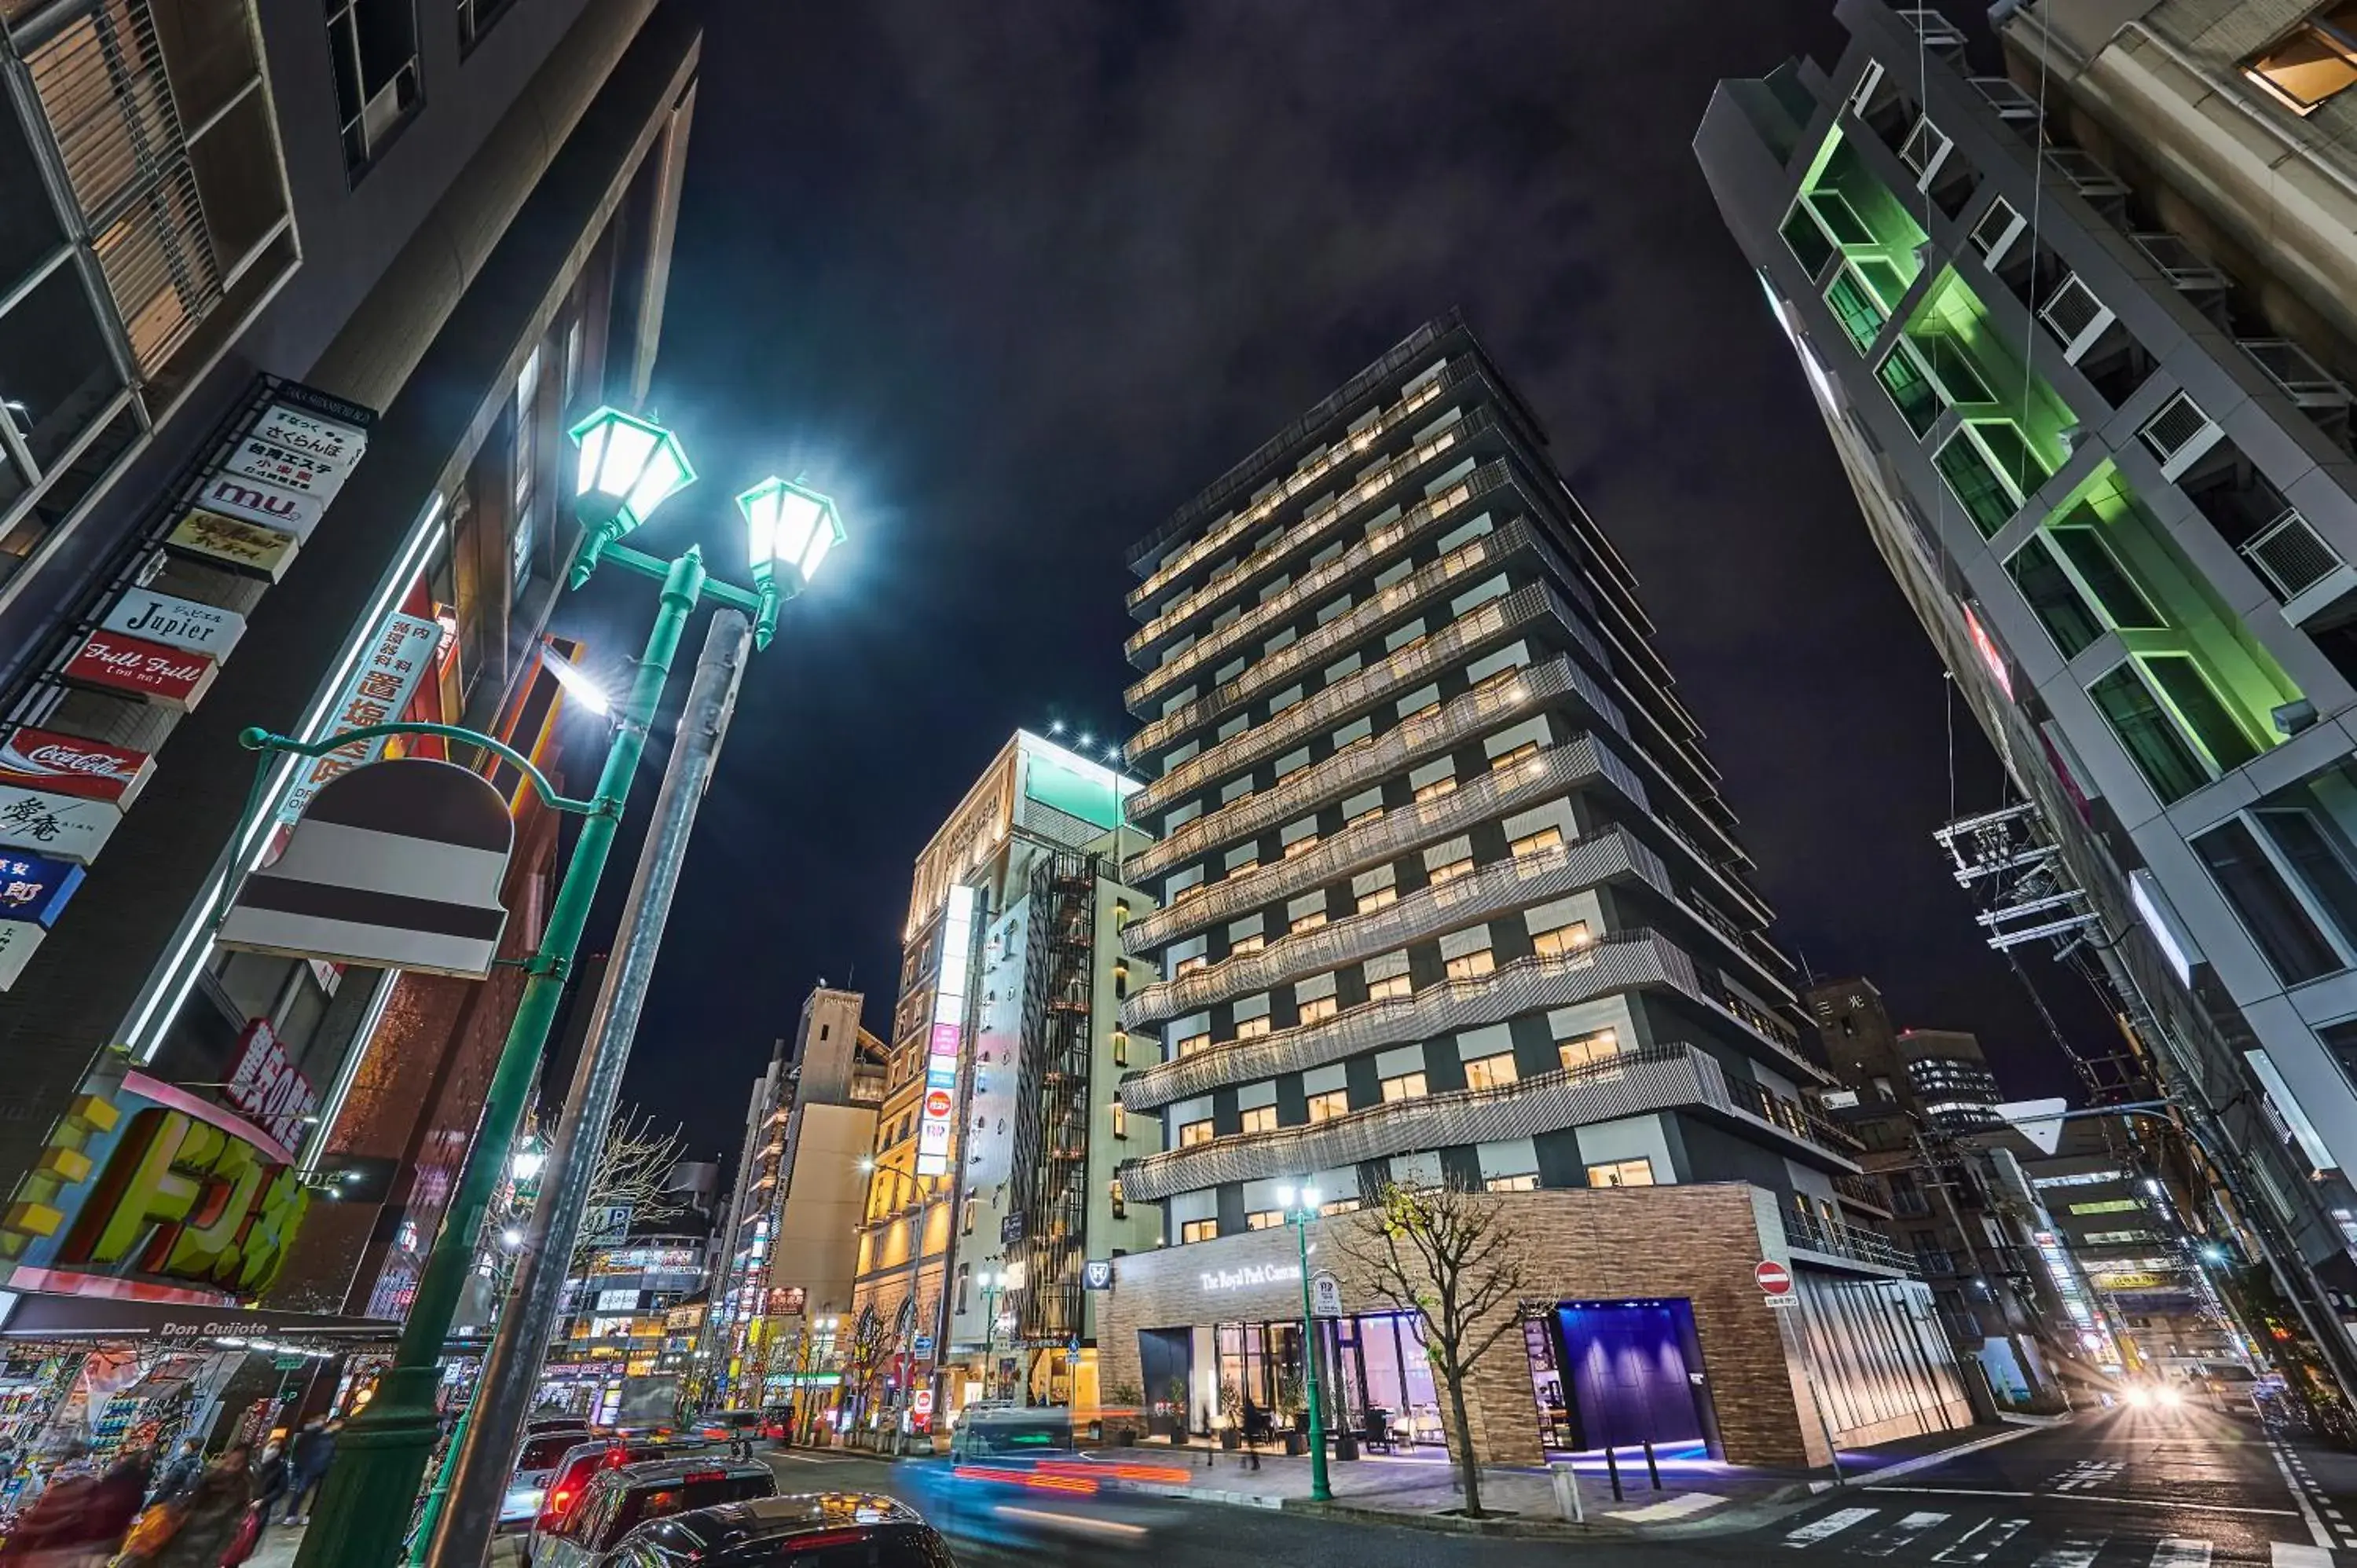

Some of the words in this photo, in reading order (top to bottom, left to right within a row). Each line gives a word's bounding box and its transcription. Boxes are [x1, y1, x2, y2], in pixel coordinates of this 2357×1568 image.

[265, 425, 345, 458] さくらんぼ
[126, 602, 214, 642] Jupier
[84, 642, 144, 668] Frill
[145, 655, 200, 682] Frill
[27, 743, 128, 776] Coca-Cola
[1199, 1273, 1219, 1291] The
[1218, 1268, 1243, 1291] Royal
[1243, 1265, 1265, 1284] Park
[160, 1321, 198, 1335] Don
[203, 1321, 268, 1336] Quijote
